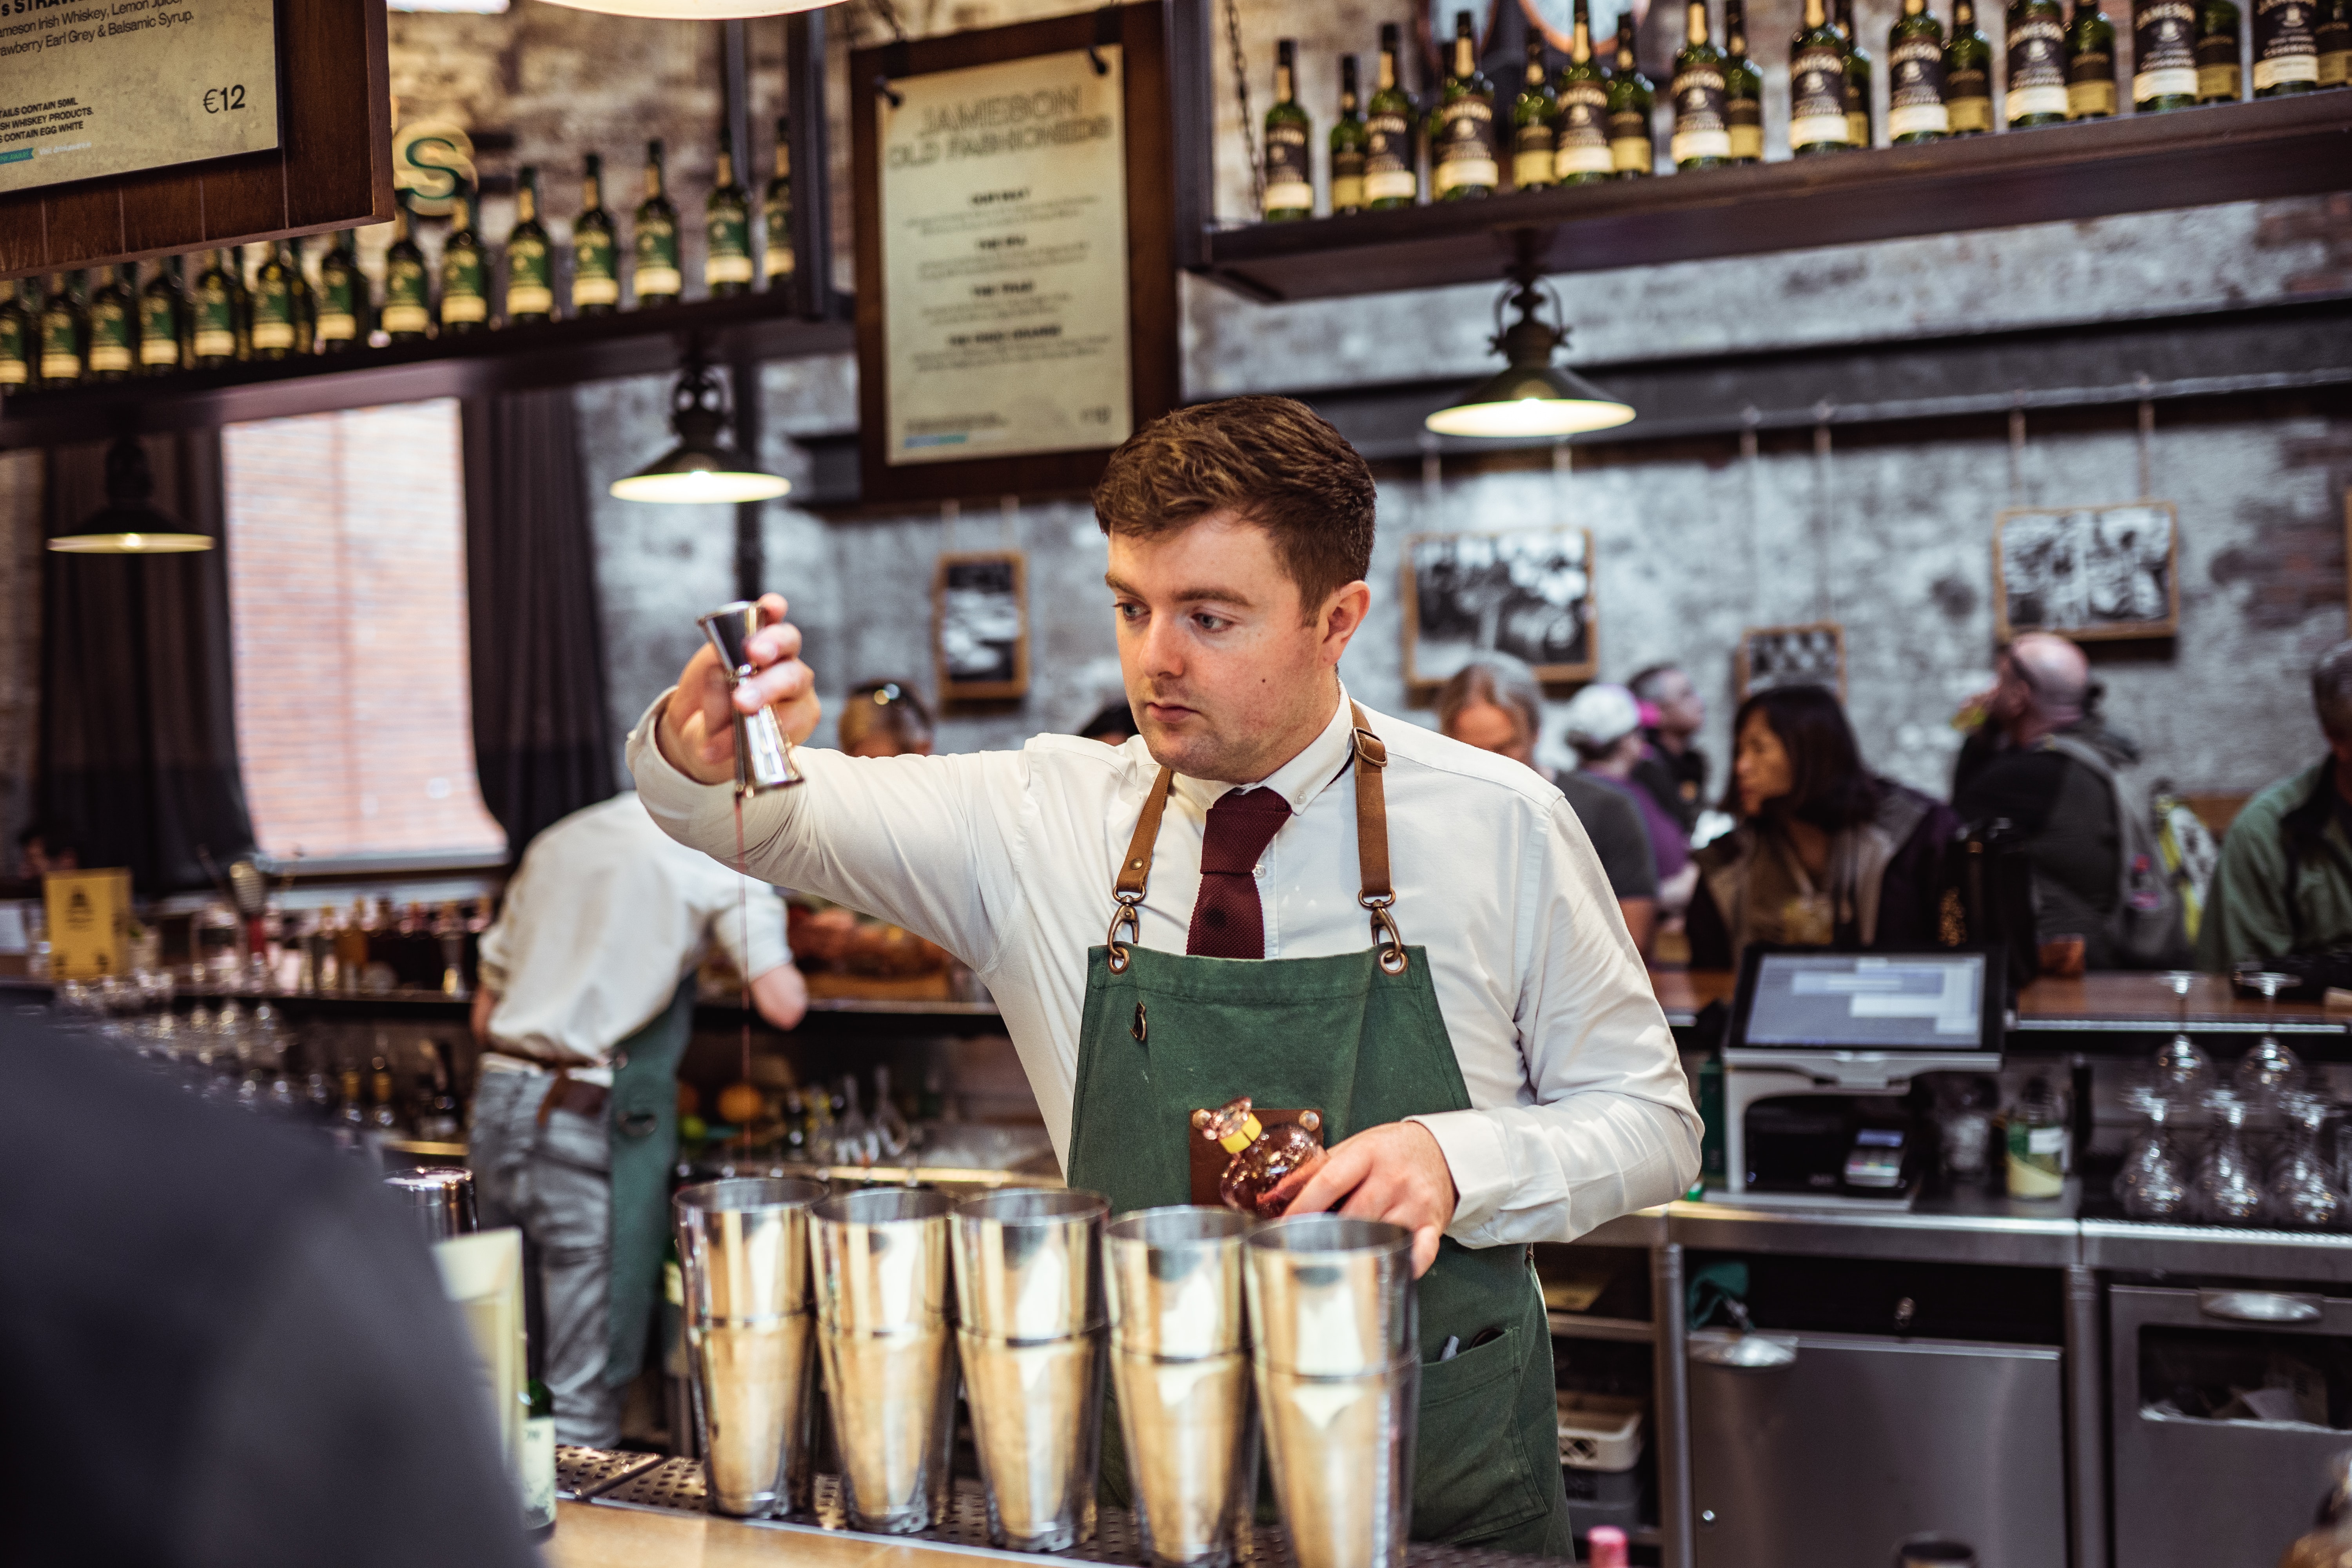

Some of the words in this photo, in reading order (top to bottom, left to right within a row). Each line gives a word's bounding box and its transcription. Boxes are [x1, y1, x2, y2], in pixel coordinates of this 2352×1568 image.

[38, 15, 60, 30] Irish
[62, 8, 109, 25] Whiskey,
[111, 0, 149, 16] Lemon
[0, 40, 44, 56] awberry
[46, 31, 66, 47] Earl
[69, 30, 95, 43] Grey
[98, 24, 106, 37] &
[108, 15, 156, 35] Balsamic
[159, 11, 194, 28] Syrup.
[21, 101, 56, 114] CONTAIN
[58, 97, 78, 108] 50ML
[203, 84, 245, 114] €12
[12, 115, 47, 128] WHISKEY
[49, 107, 94, 122] PRODUCTS.
[4, 129, 38, 142] CONTAIN
[40, 125, 57, 136] EGG
[59, 121, 83, 132] WHITE
